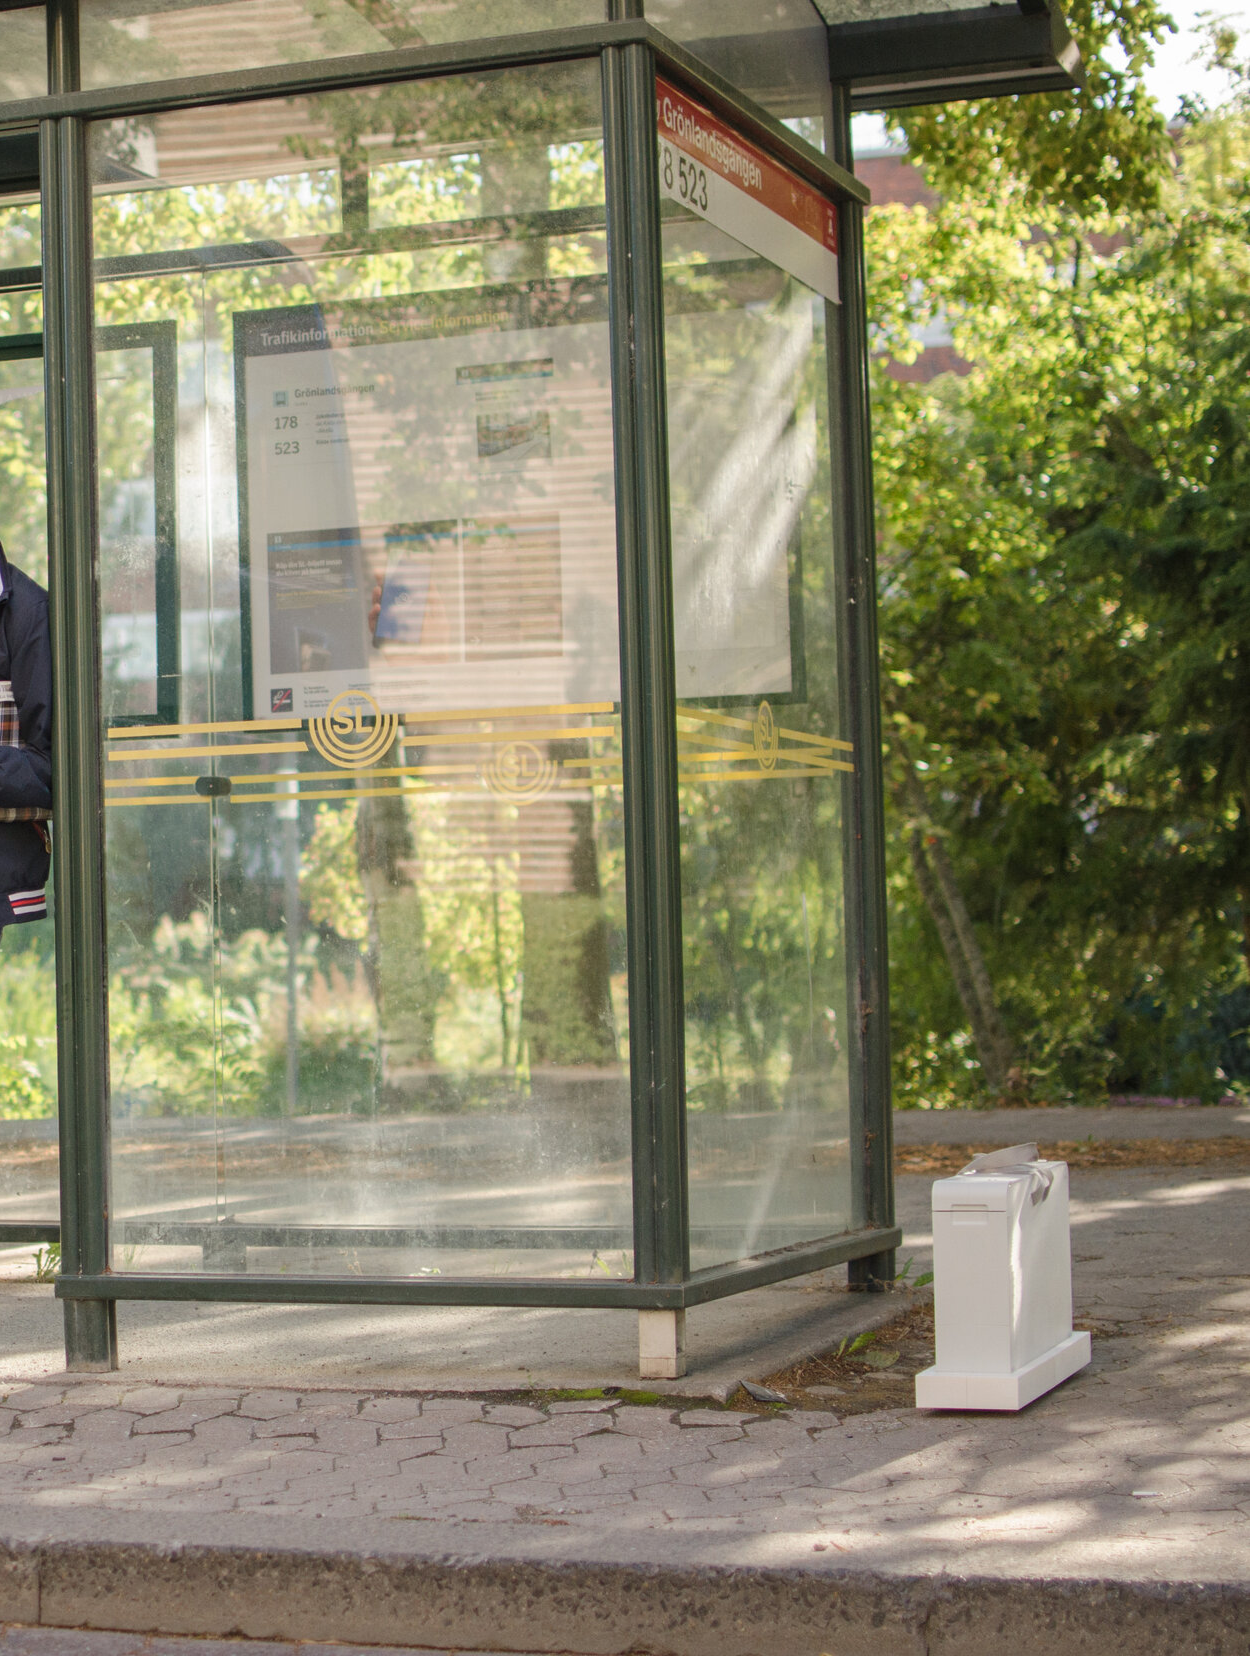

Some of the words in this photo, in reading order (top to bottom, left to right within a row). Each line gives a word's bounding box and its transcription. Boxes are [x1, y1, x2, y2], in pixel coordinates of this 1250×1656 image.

[663, 97, 763, 190] Grönlandsgången
[679, 156, 708, 212] 523
[260, 324, 374, 346] Trafikinformation
[380, 316, 431, 334] Service
[294, 384, 375, 398] Grönlandsgången
[274, 415, 298, 430] 178
[274, 440, 300, 456] 523
[333, 705, 374, 735] SL
[758, 714, 772, 743] SL
[503, 754, 536, 778] SL
